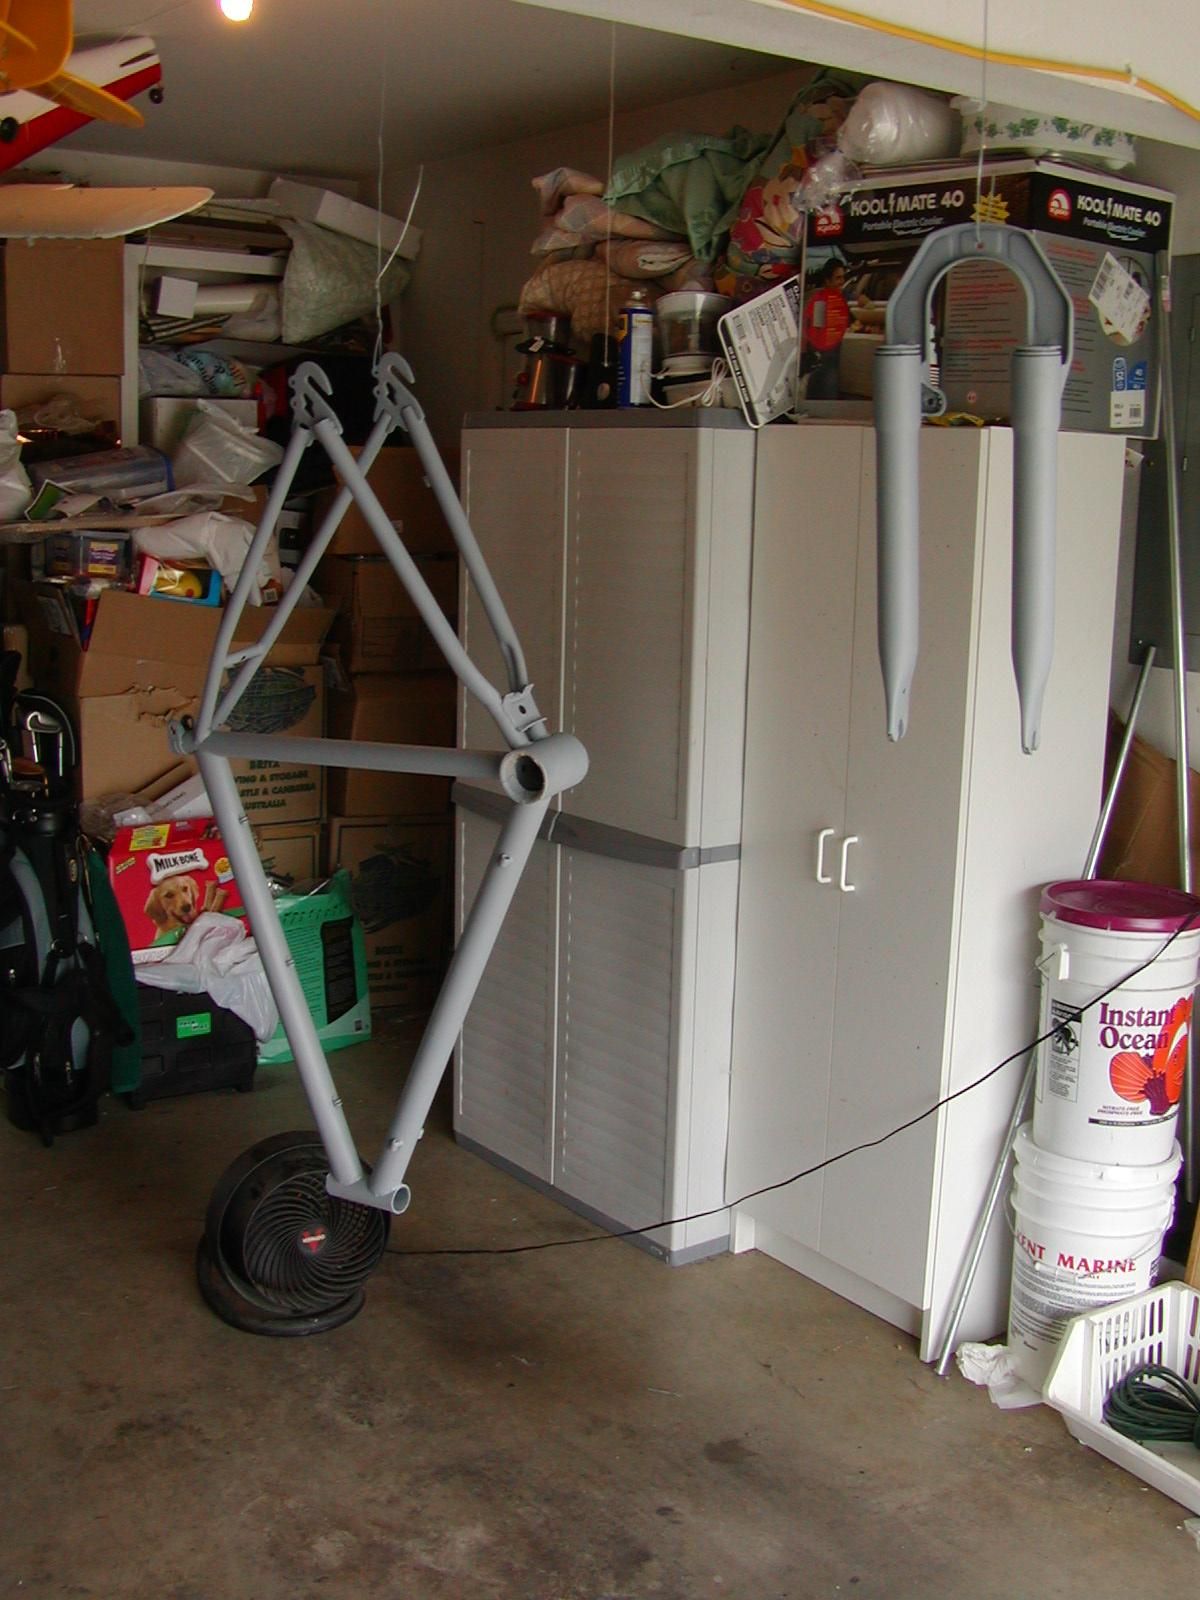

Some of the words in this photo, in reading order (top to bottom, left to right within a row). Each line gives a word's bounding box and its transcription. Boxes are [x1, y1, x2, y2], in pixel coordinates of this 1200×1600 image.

[940, 189, 965, 208] 40
[1144, 210, 1161, 227] 40
[269, 769, 309, 781] STORAGE
[243, 798, 287, 810] USTRALIA
[1100, 1025, 1169, 1050] Ocean
[1056, 1252, 1137, 1274] MARINE
